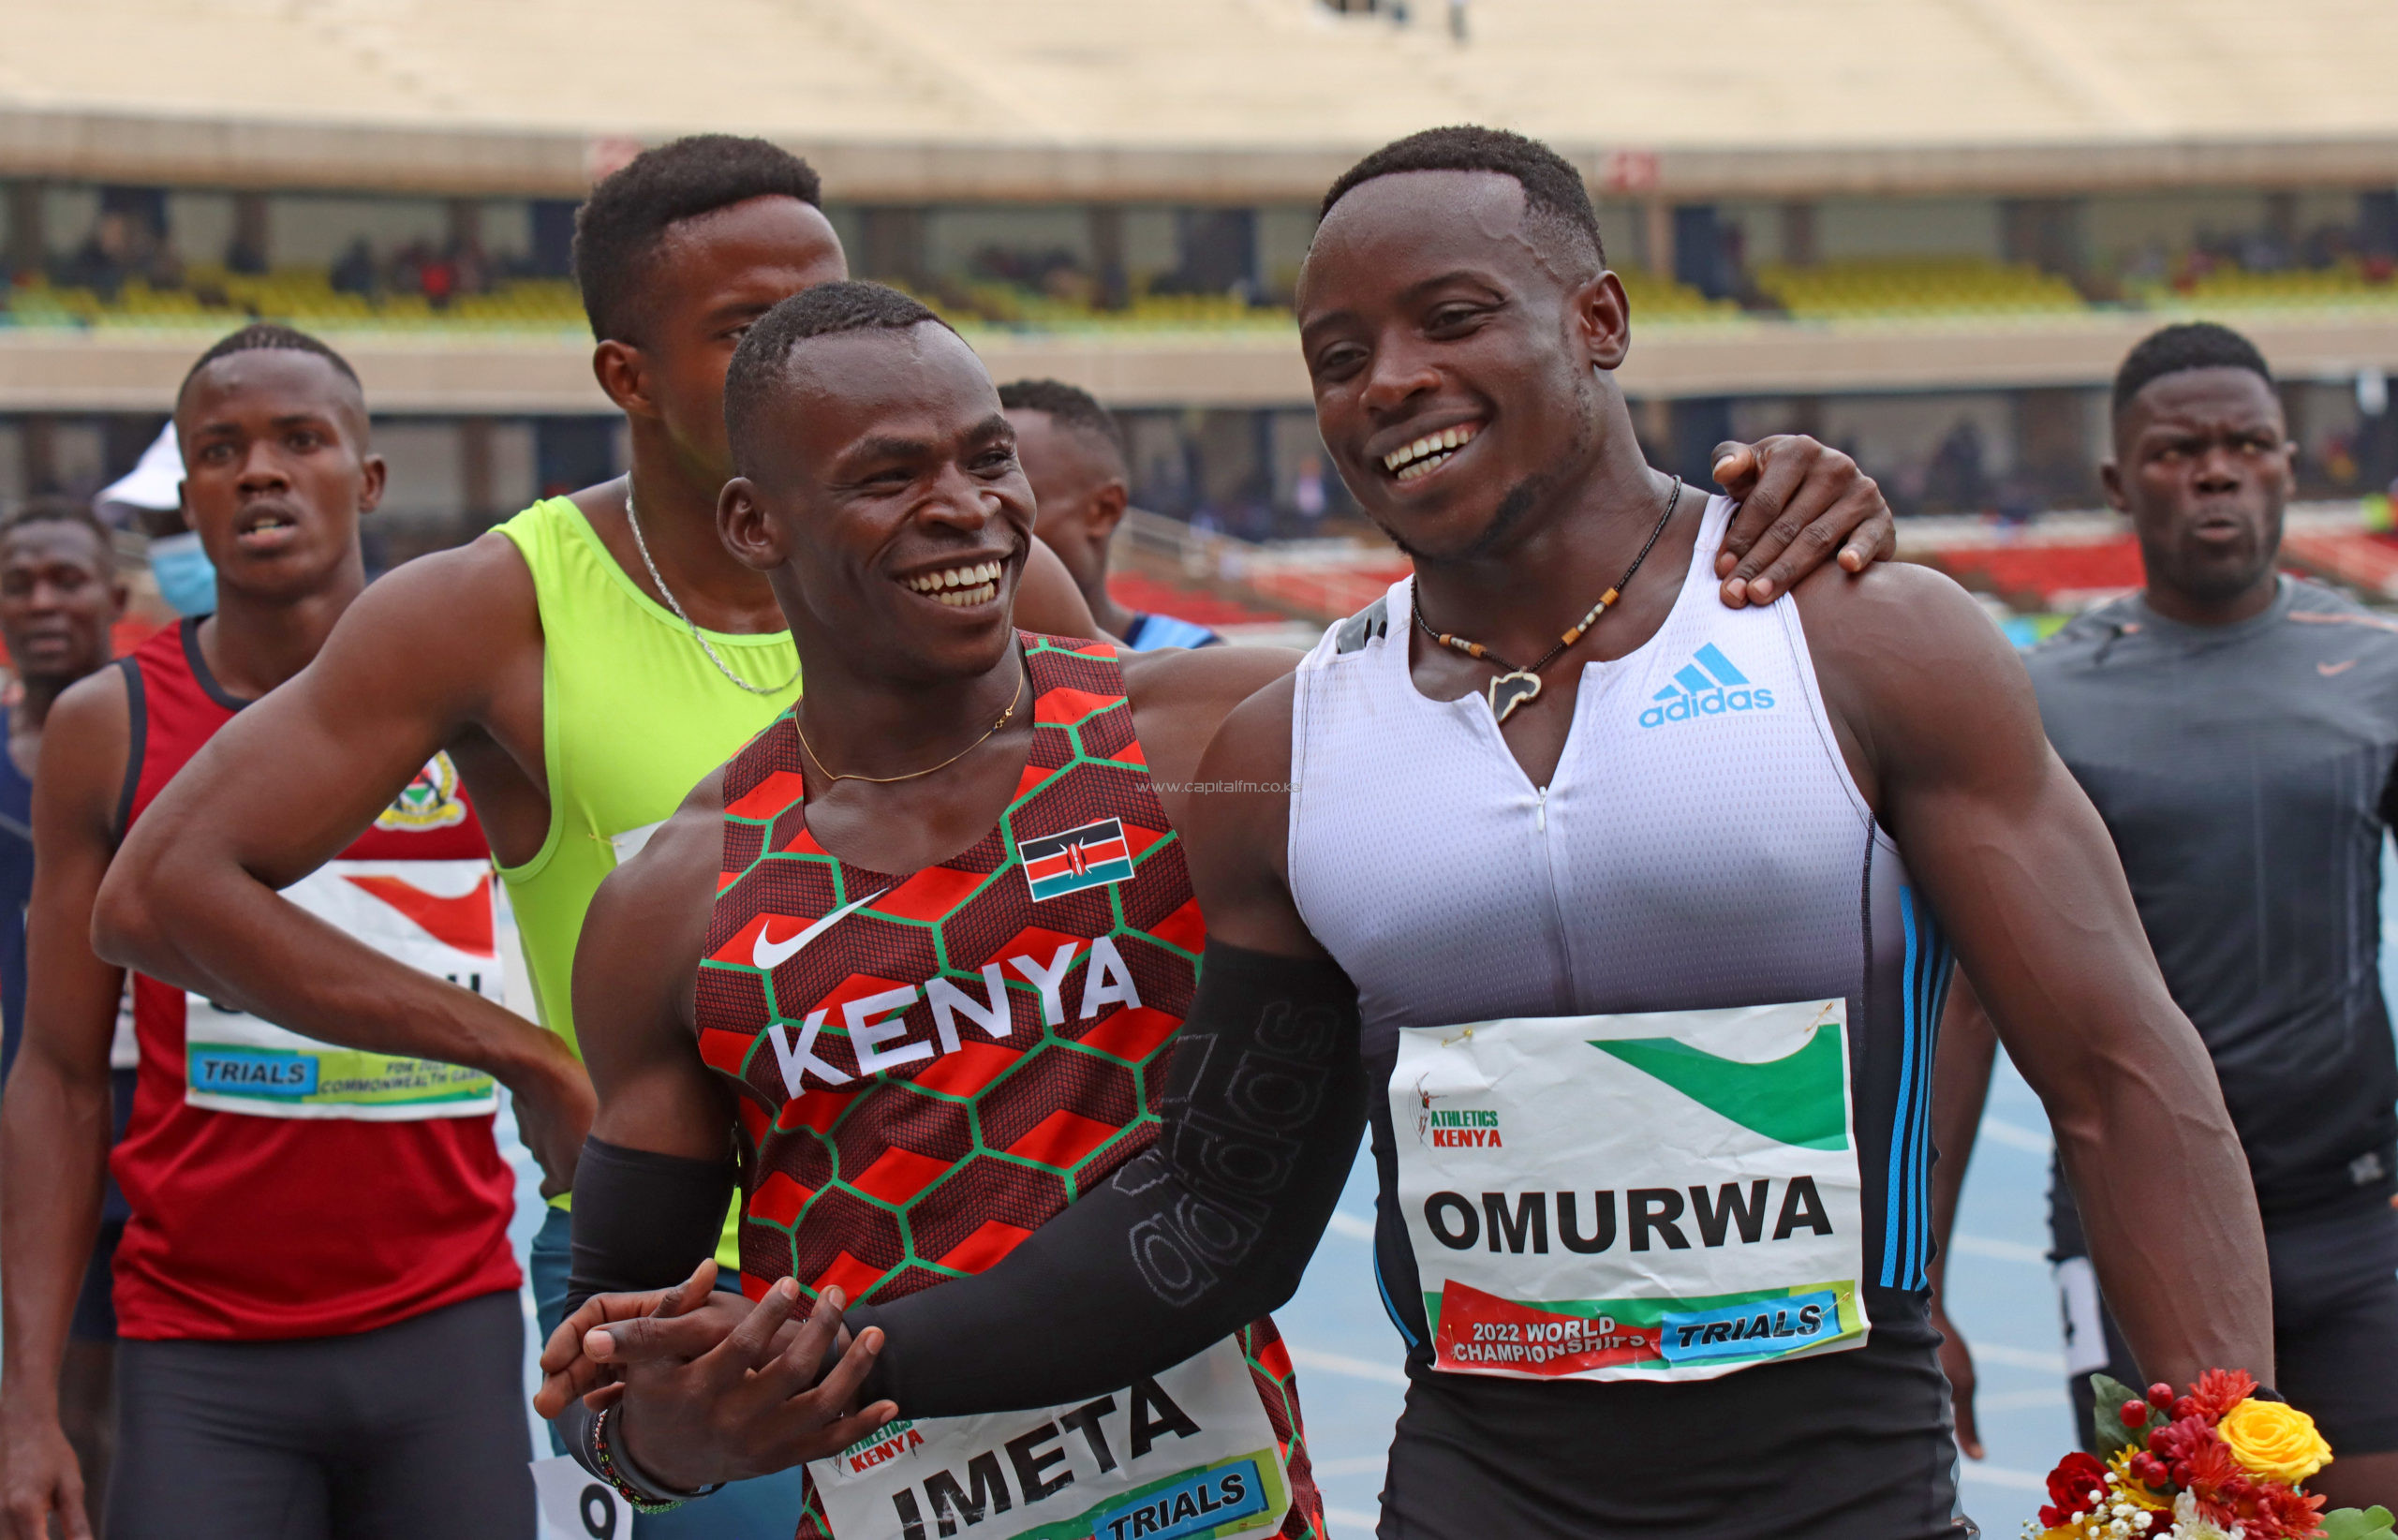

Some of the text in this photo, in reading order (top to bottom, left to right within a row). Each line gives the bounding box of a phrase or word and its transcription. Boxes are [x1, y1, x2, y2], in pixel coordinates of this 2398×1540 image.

[1638, 687, 1776, 729] adidas
[767, 935, 1143, 1101] KENYA
[202, 1059, 306, 1086] TRIALS
[320, 1072, 447, 1094] COMMONWEALTH
[1430, 1109, 1499, 1128] ATHLETICS
[1432, 1129, 1503, 1148] KENYA
[1423, 1175, 1834, 1255] OMURWA
[1472, 1314, 1617, 1343] 2022 WORLD
[1676, 1303, 1824, 1349] TRIALS
[849, 1428, 925, 1473] KENYA
[893, 1375, 1202, 1540] IMETA
[1107, 1473, 1246, 1540] TRIALS
